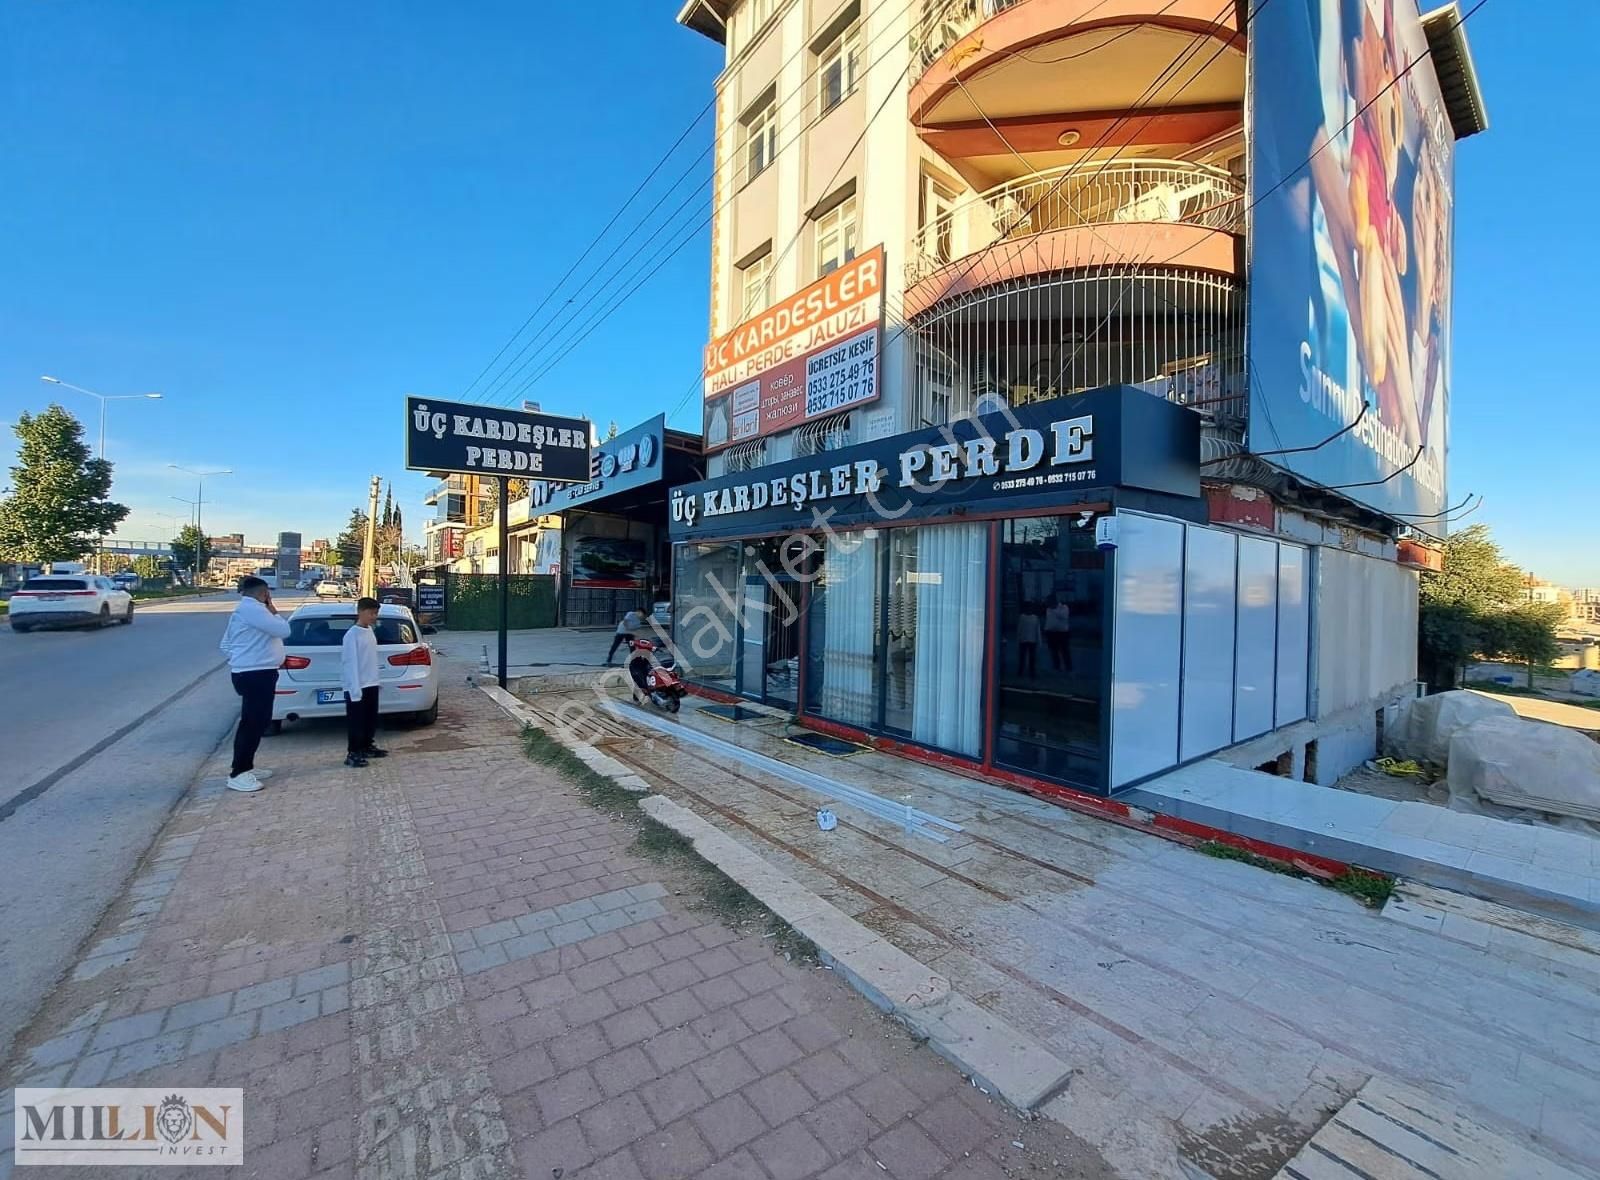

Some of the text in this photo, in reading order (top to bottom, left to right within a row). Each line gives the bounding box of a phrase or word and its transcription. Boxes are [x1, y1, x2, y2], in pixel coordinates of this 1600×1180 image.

[706, 258, 878, 372] ÜÇ KARDEŞLER
[712, 303, 867, 392] HALI PERDE JALUZİ
[808, 336, 874, 376] ÜCRETSİZ KEŞİF
[807, 358, 874, 396] 0533 275 49 76
[807, 377, 874, 414] 0532 715 07 76
[1299, 340, 1348, 442] Sunny
[413, 404, 586, 450] ÜÇ KARDEŞLER
[466, 446, 543, 472] PERDE
[671, 414, 1094, 527] ÜÇ KARDEŞLER PERDE
[1048, 473, 1063, 484] 0532
[1064, 472, 1077, 482] 715
[1077, 471, 1087, 481] 07
[1087, 470, 1096, 480] 76
